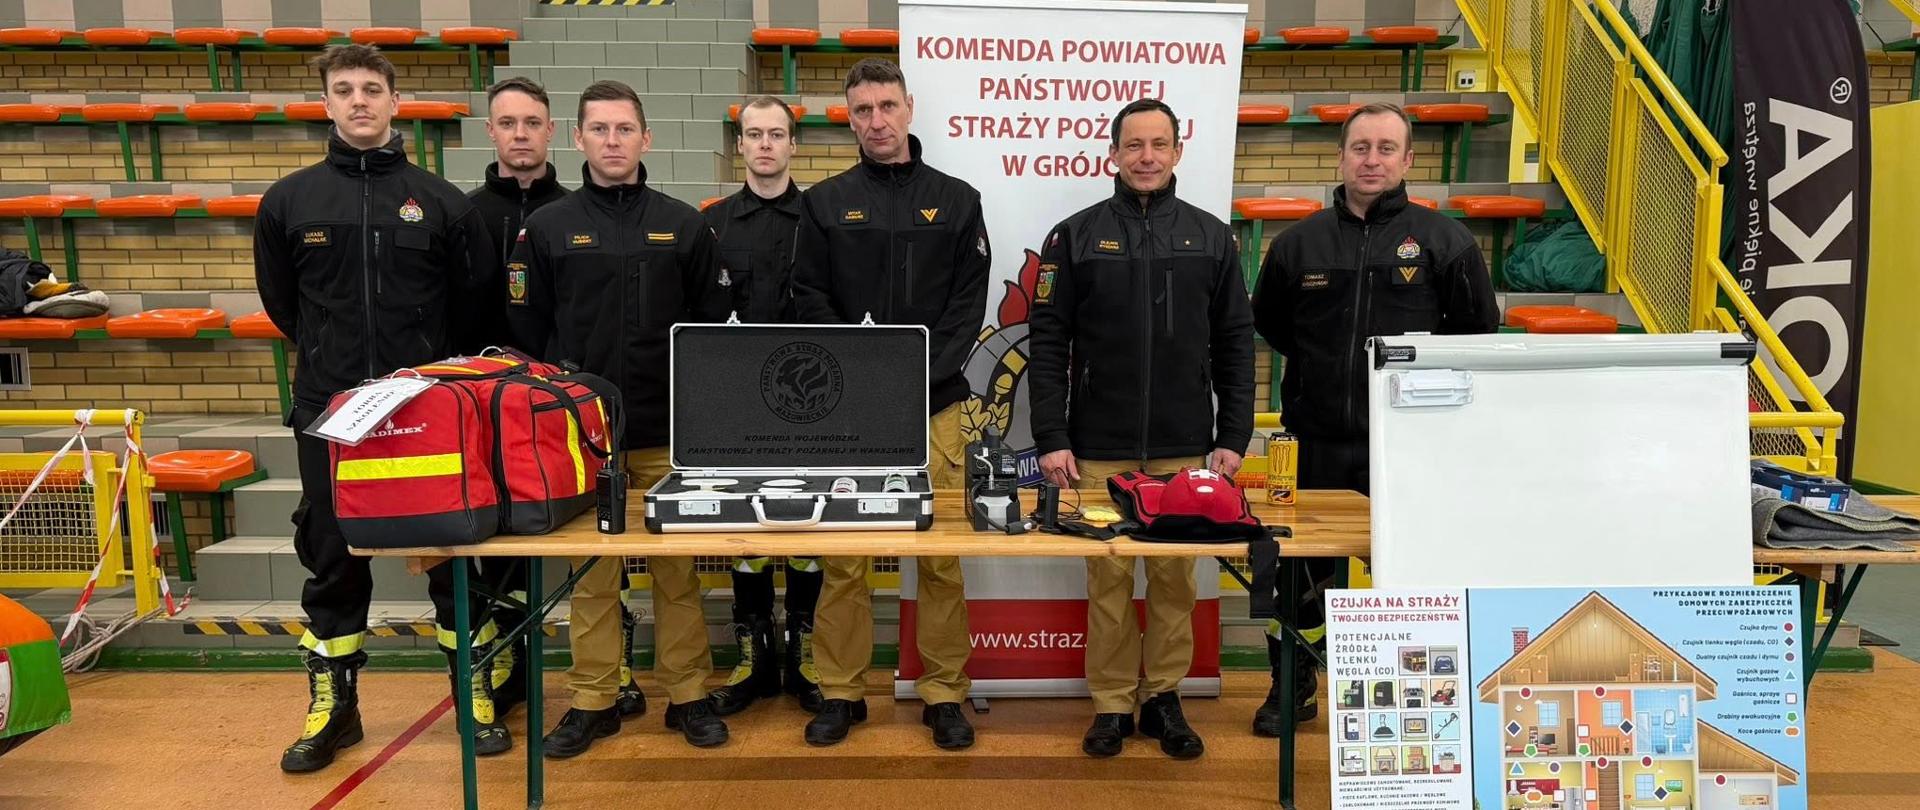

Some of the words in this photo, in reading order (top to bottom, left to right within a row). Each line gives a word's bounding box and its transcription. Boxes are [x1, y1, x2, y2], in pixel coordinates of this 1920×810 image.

[916, 36, 1054, 62] KOMENDA
[1062, 40, 1226, 65] POWIATOWA
[979, 73, 1165, 103] PAŃSTWOWEJ
[948, 111, 1050, 140] STRAŻY
[1002, 155, 1027, 176] W
[1033, 151, 1120, 178] GRÓJC
[365, 426, 423, 439] ADIMEX
[1331, 597, 1382, 608] CZUJKA
[1386, 597, 1404, 608] NA
[1408, 594, 1460, 608] STRAŻY
[1332, 614, 1375, 622] TWOJEGO
[1378, 612, 1460, 622] BEZPIECZEŃSTWA
[1696, 608, 1793, 616] PRZECIWPOŻAROWYCH
[1335, 632, 1412, 642] POTENCJALNE
[1335, 643, 1378, 653] ŹRÓDŁA
[1336, 656, 1377, 664] TLENKU
[1337, 667, 1371, 676] WĘGLA
[1374, 666, 1395, 676] (CO)
